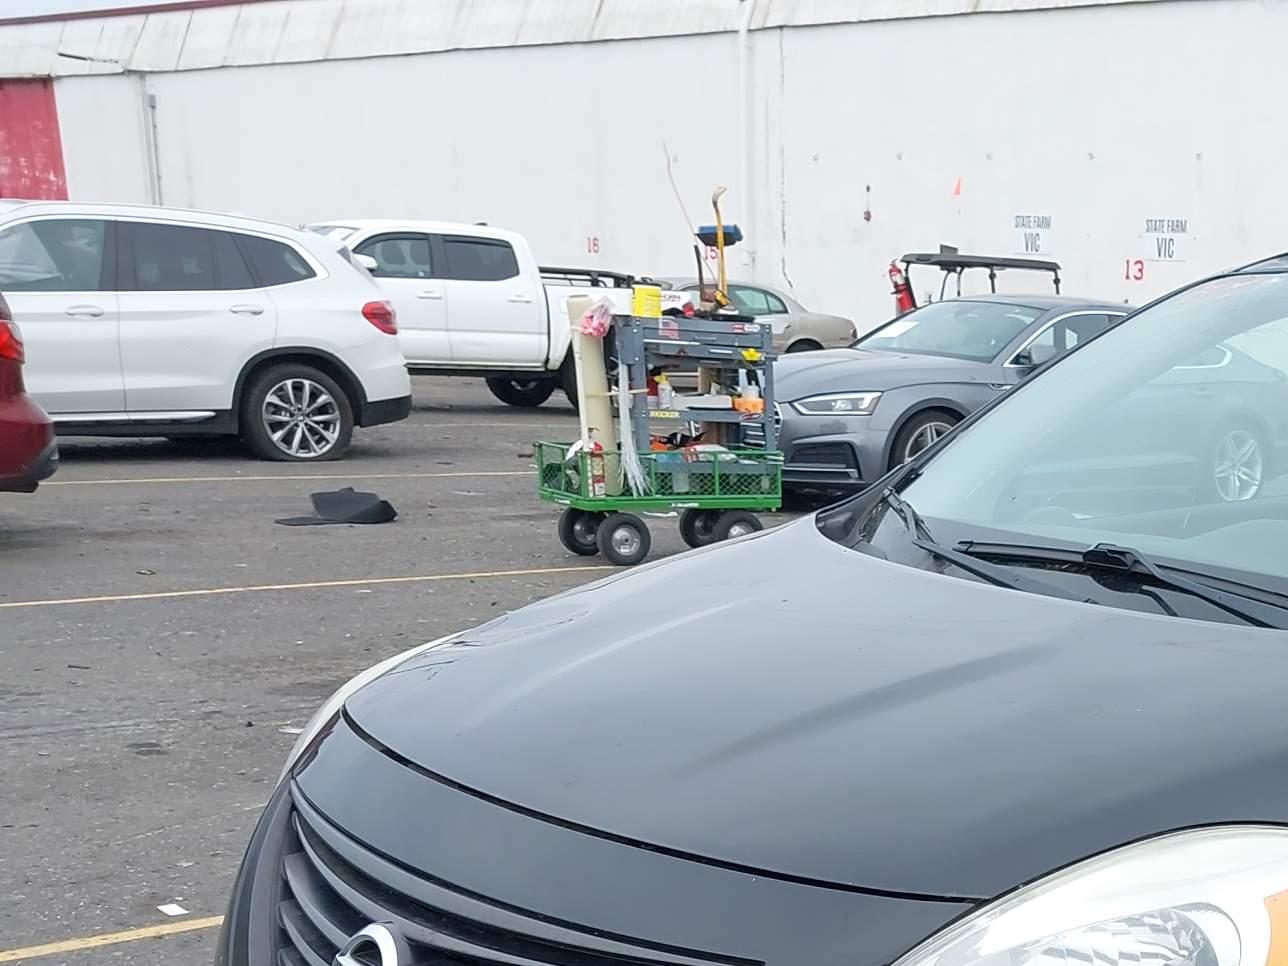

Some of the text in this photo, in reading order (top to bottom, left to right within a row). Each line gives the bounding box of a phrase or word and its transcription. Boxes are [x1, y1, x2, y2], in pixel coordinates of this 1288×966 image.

[1015, 215, 1051, 229] STATE FARM
[1146, 219, 1188, 234] STATE FARM
[587, 237, 600, 254] 16
[1024, 233, 1041, 253] VIC
[1157, 237, 1175, 259] VIC
[703, 245, 718, 260] 15
[1125, 258, 1145, 280] 13
